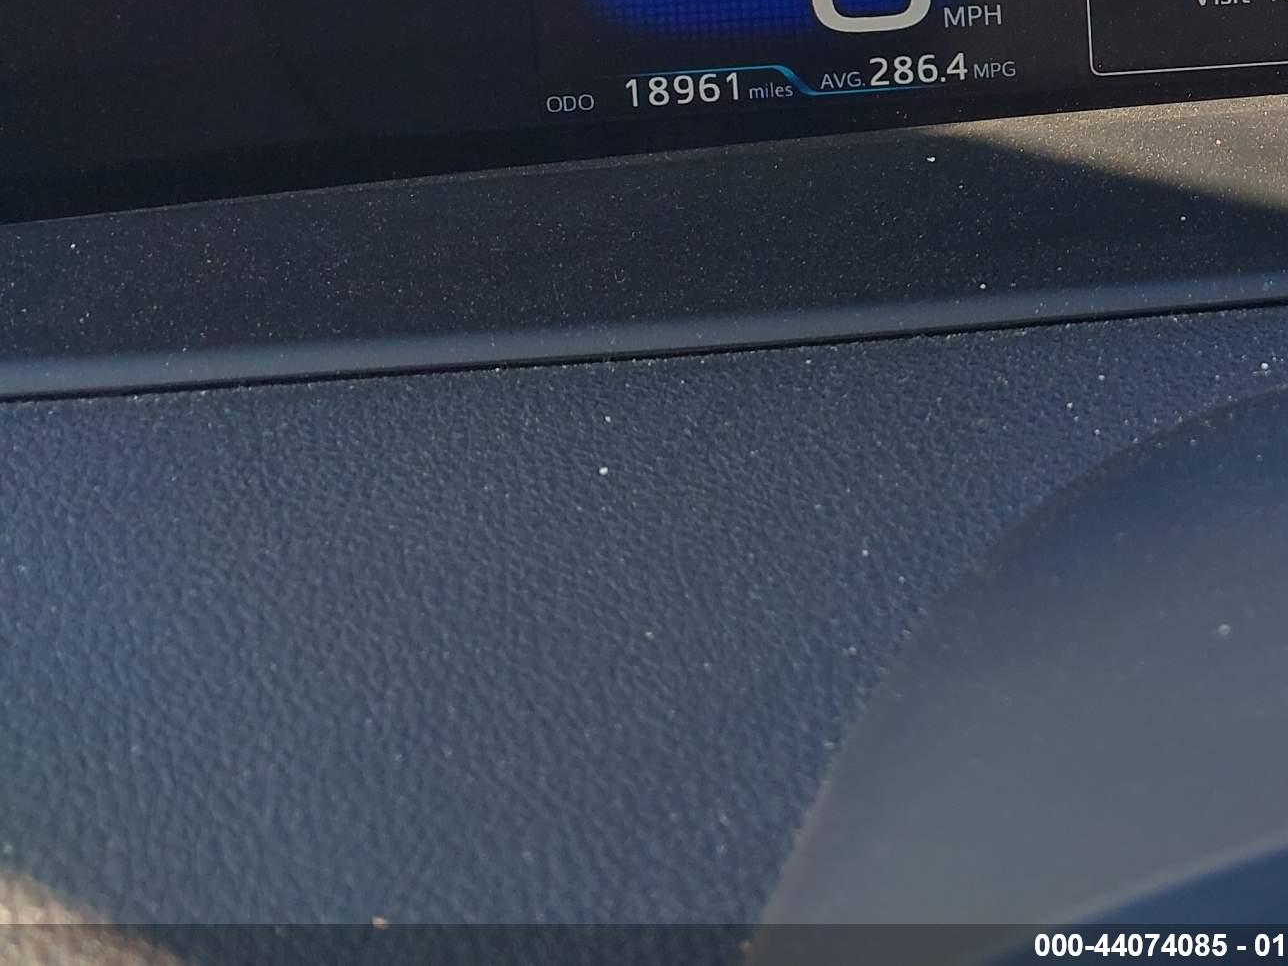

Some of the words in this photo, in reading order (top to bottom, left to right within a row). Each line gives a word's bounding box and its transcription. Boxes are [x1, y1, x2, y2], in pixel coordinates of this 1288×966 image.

[943, 4, 1003, 28] MPH
[869, 52, 968, 87] 286.4
[973, 60, 1017, 80] MPG
[546, 94, 594, 113] ODO
[625, 72, 741, 108] 18961
[748, 81, 793, 99] miles
